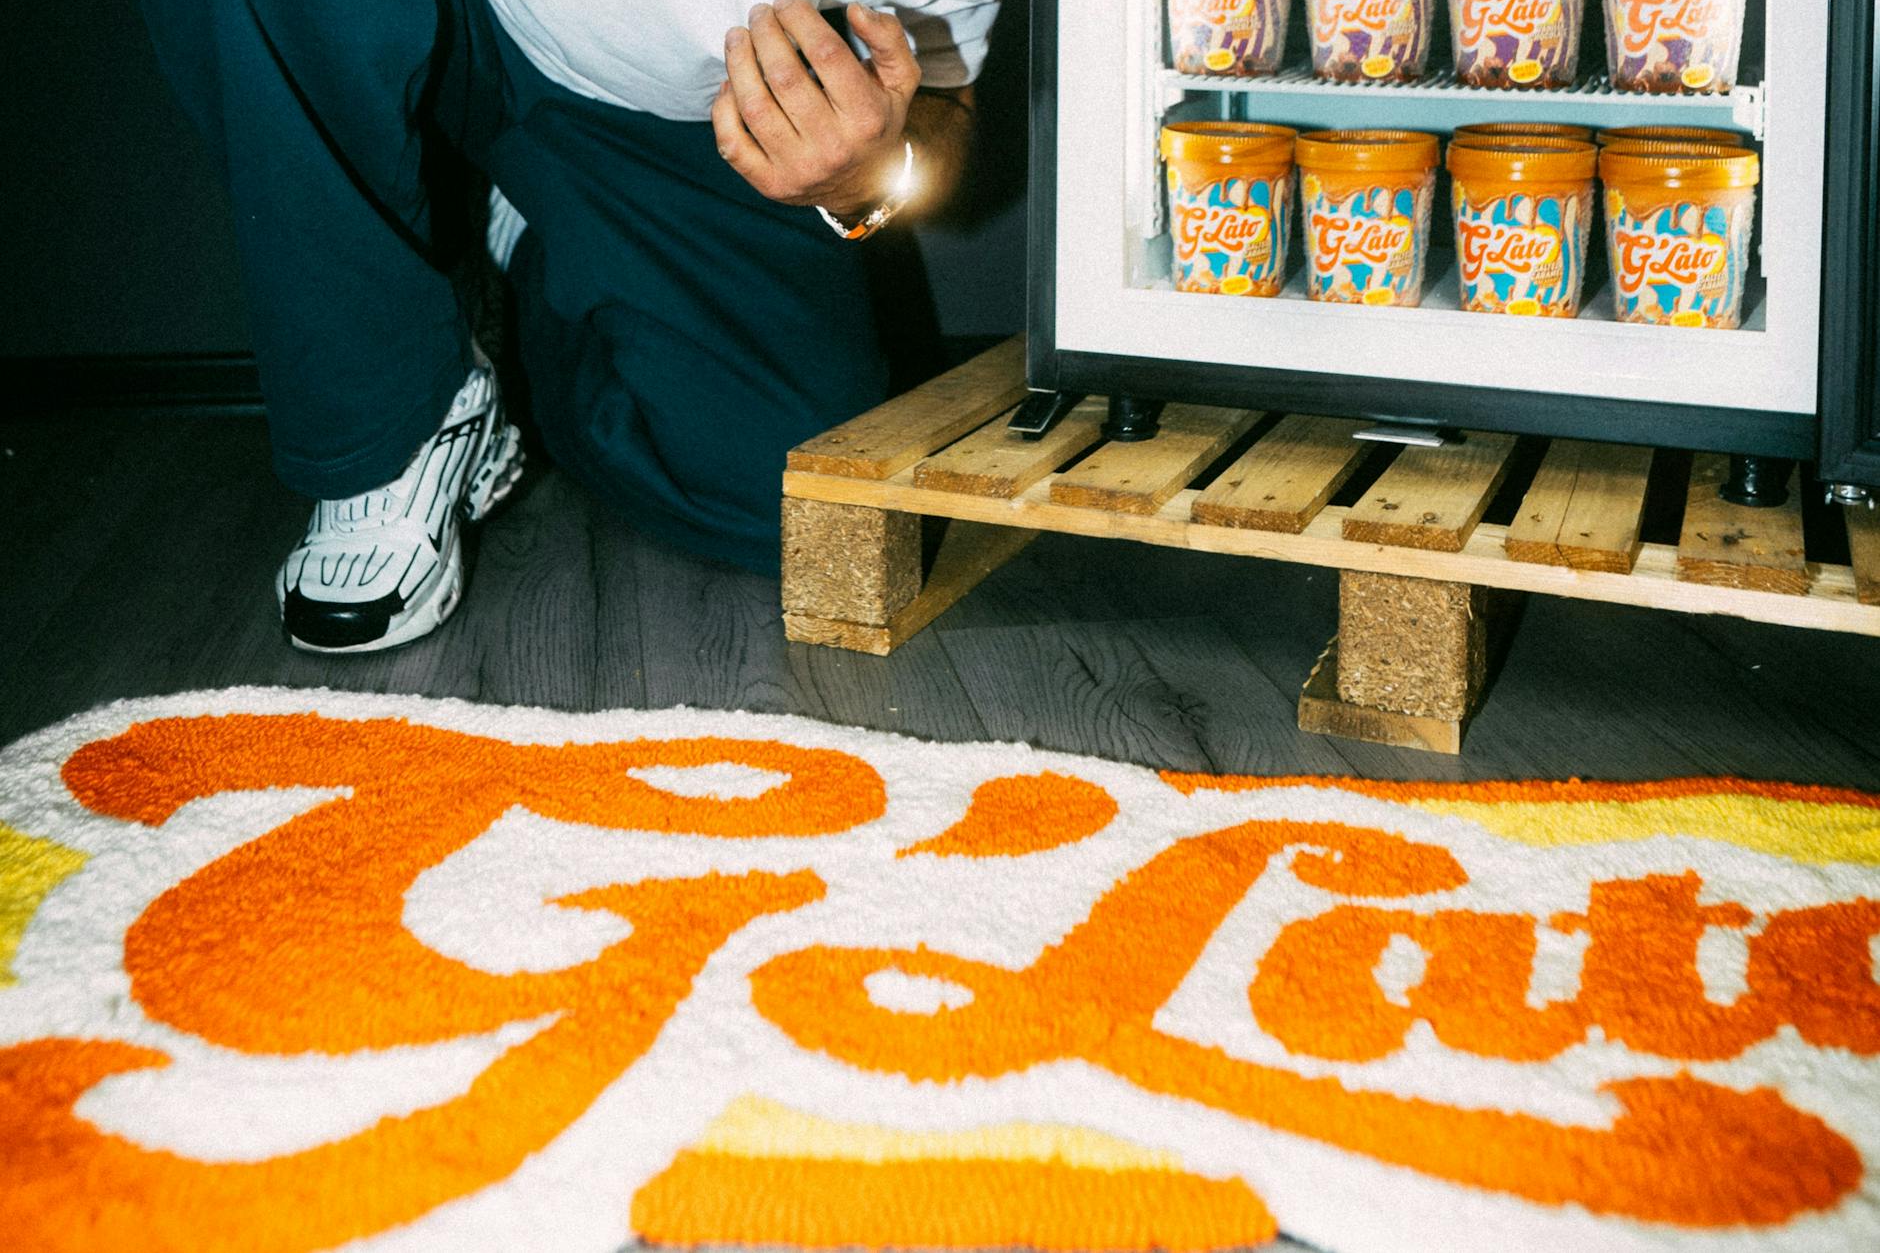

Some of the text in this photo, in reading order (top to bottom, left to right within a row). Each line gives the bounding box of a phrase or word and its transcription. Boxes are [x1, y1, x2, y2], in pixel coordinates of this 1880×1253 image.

[1174, 204, 1261, 260] G'Lato
[1312, 213, 1405, 273] G'Lato
[1458, 221, 1551, 282] G'Lato
[1615, 230, 1718, 294] G'Lato
